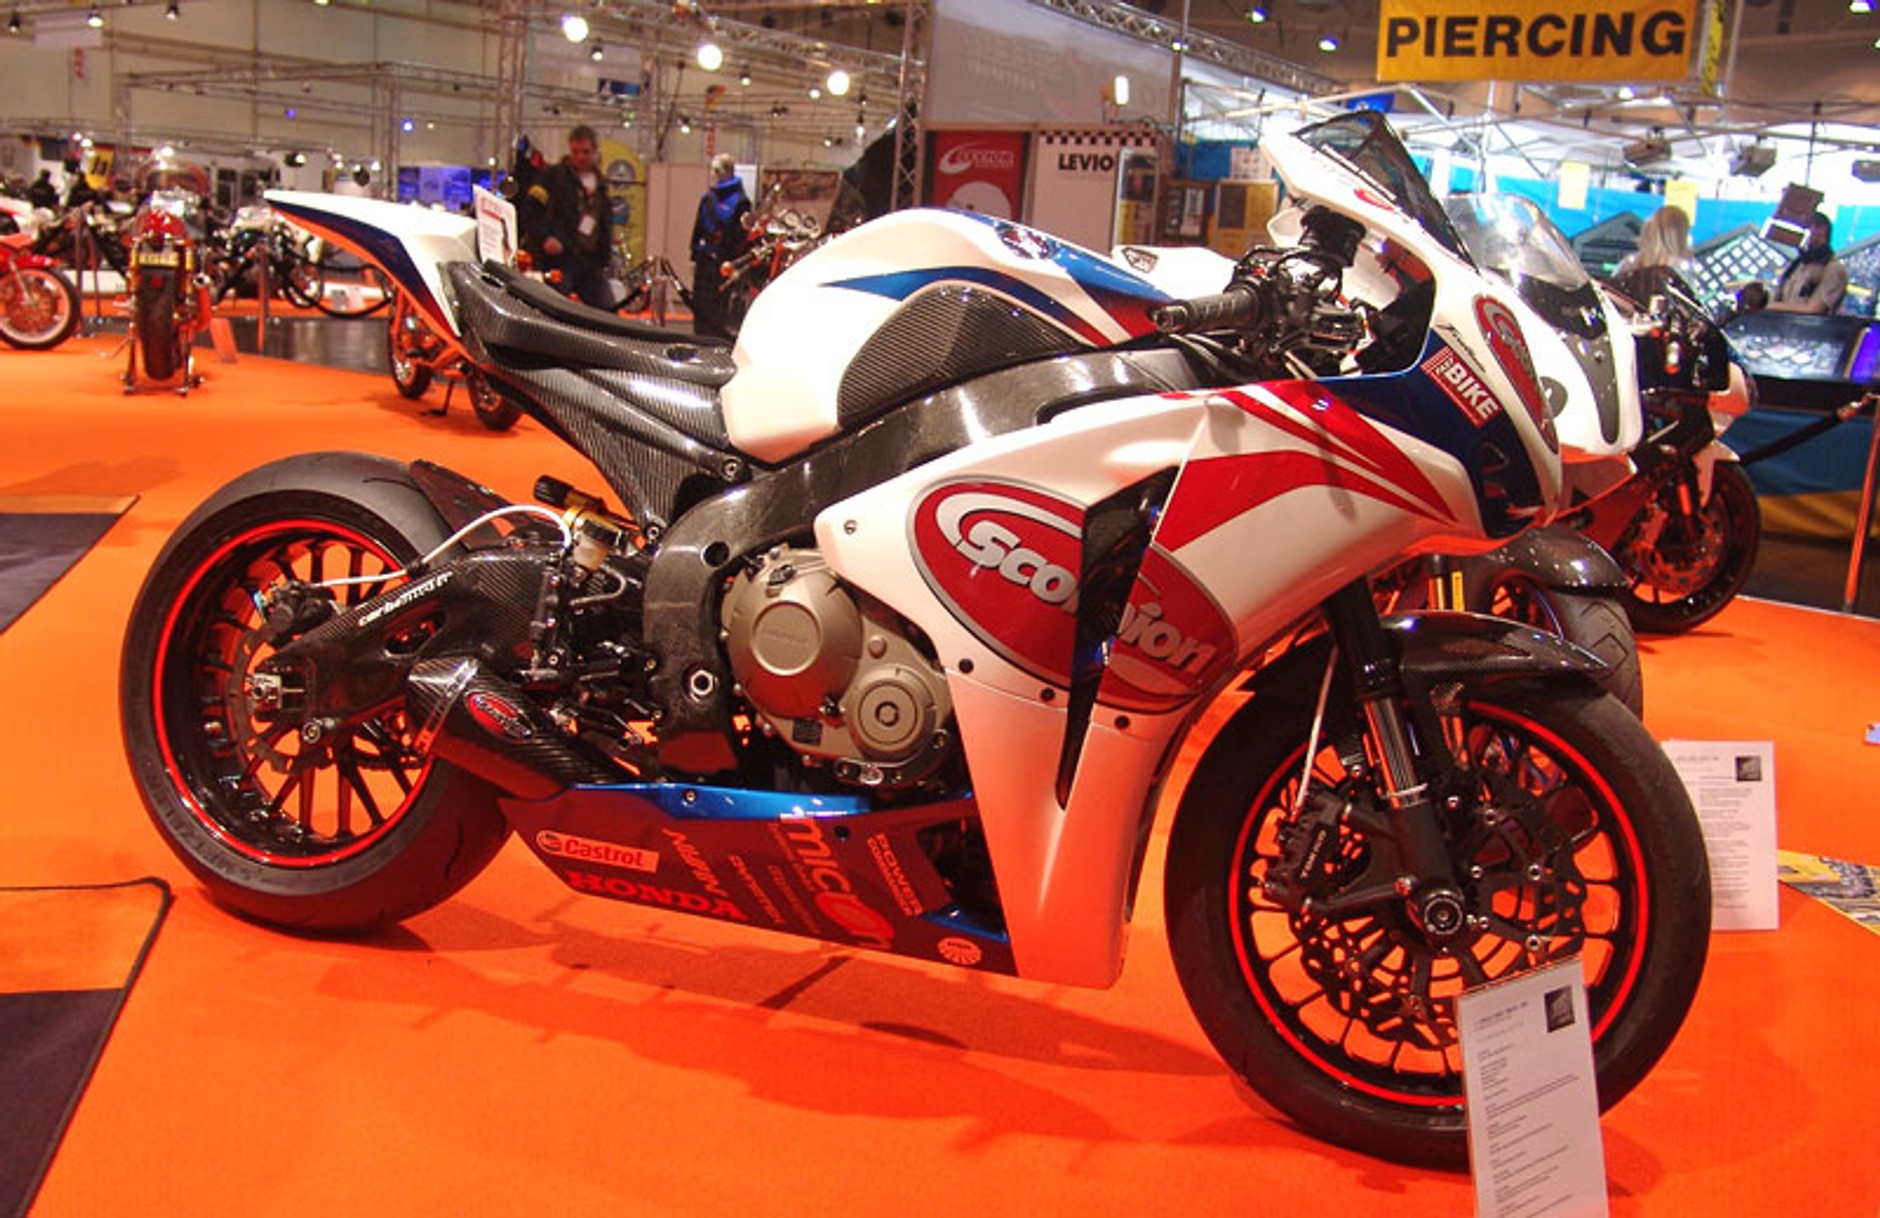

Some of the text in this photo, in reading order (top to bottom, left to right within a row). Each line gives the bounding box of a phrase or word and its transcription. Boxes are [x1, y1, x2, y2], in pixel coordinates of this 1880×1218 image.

[1386, 11, 1687, 58] PIERCING
[1058, 153, 1114, 172] LEVIO
[1444, 362, 1499, 420] BIKE
[952, 517, 1218, 675] Scoion
[563, 838, 644, 867] Castrol
[874, 832, 924, 917] POWER
[565, 869, 749, 921] HONDA
